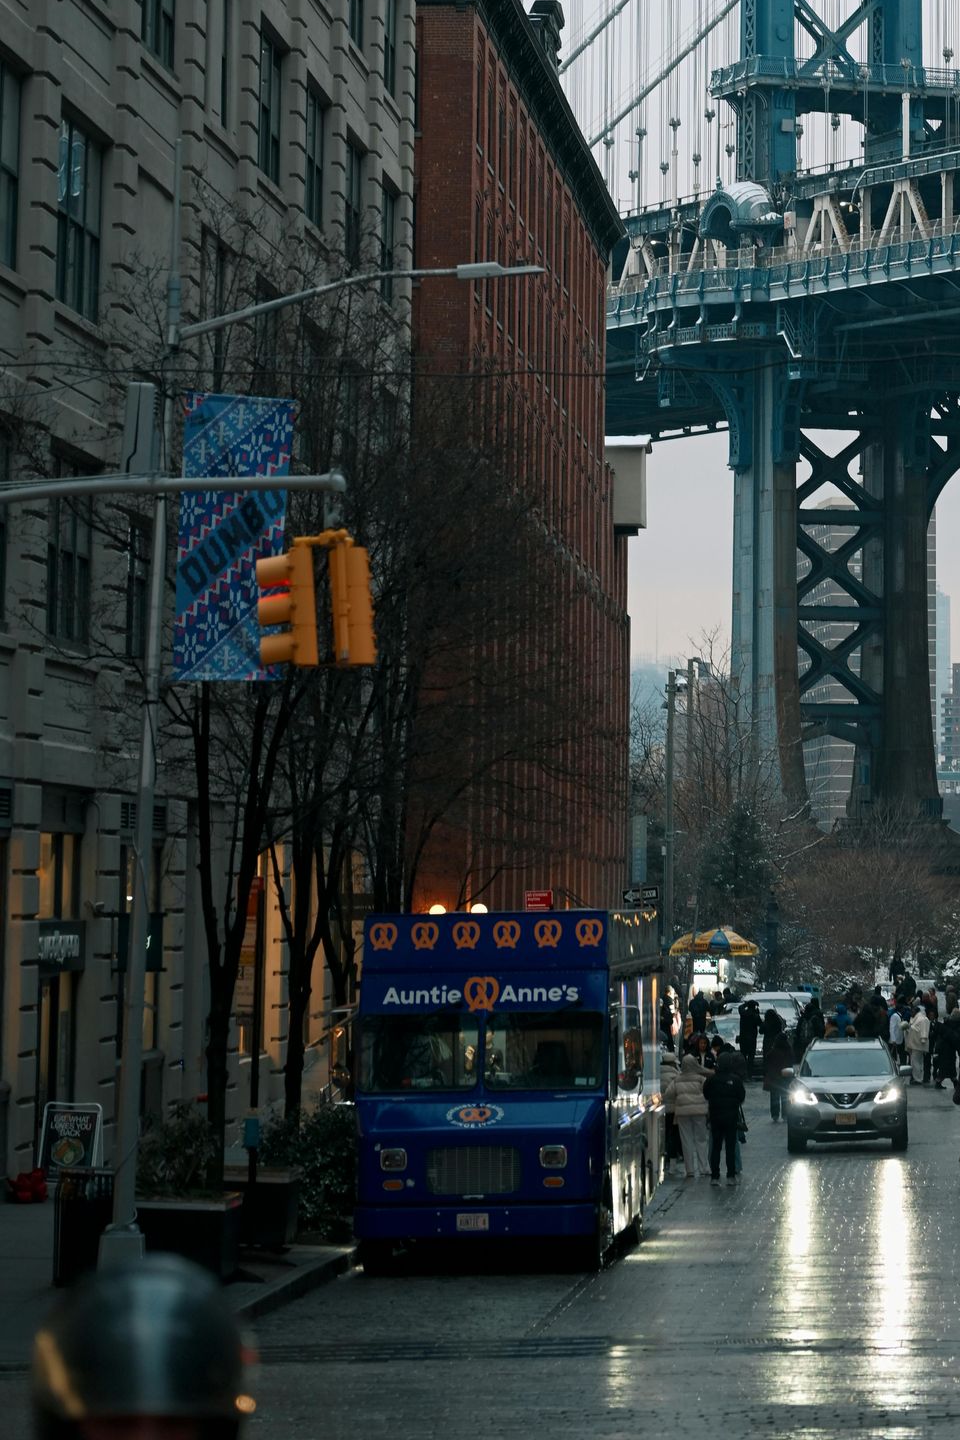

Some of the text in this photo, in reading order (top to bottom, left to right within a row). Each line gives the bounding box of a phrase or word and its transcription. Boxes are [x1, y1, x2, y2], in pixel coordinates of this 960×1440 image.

[179, 488, 285, 595] DUMBO
[382, 984, 579, 1005] Auntie Anne's
